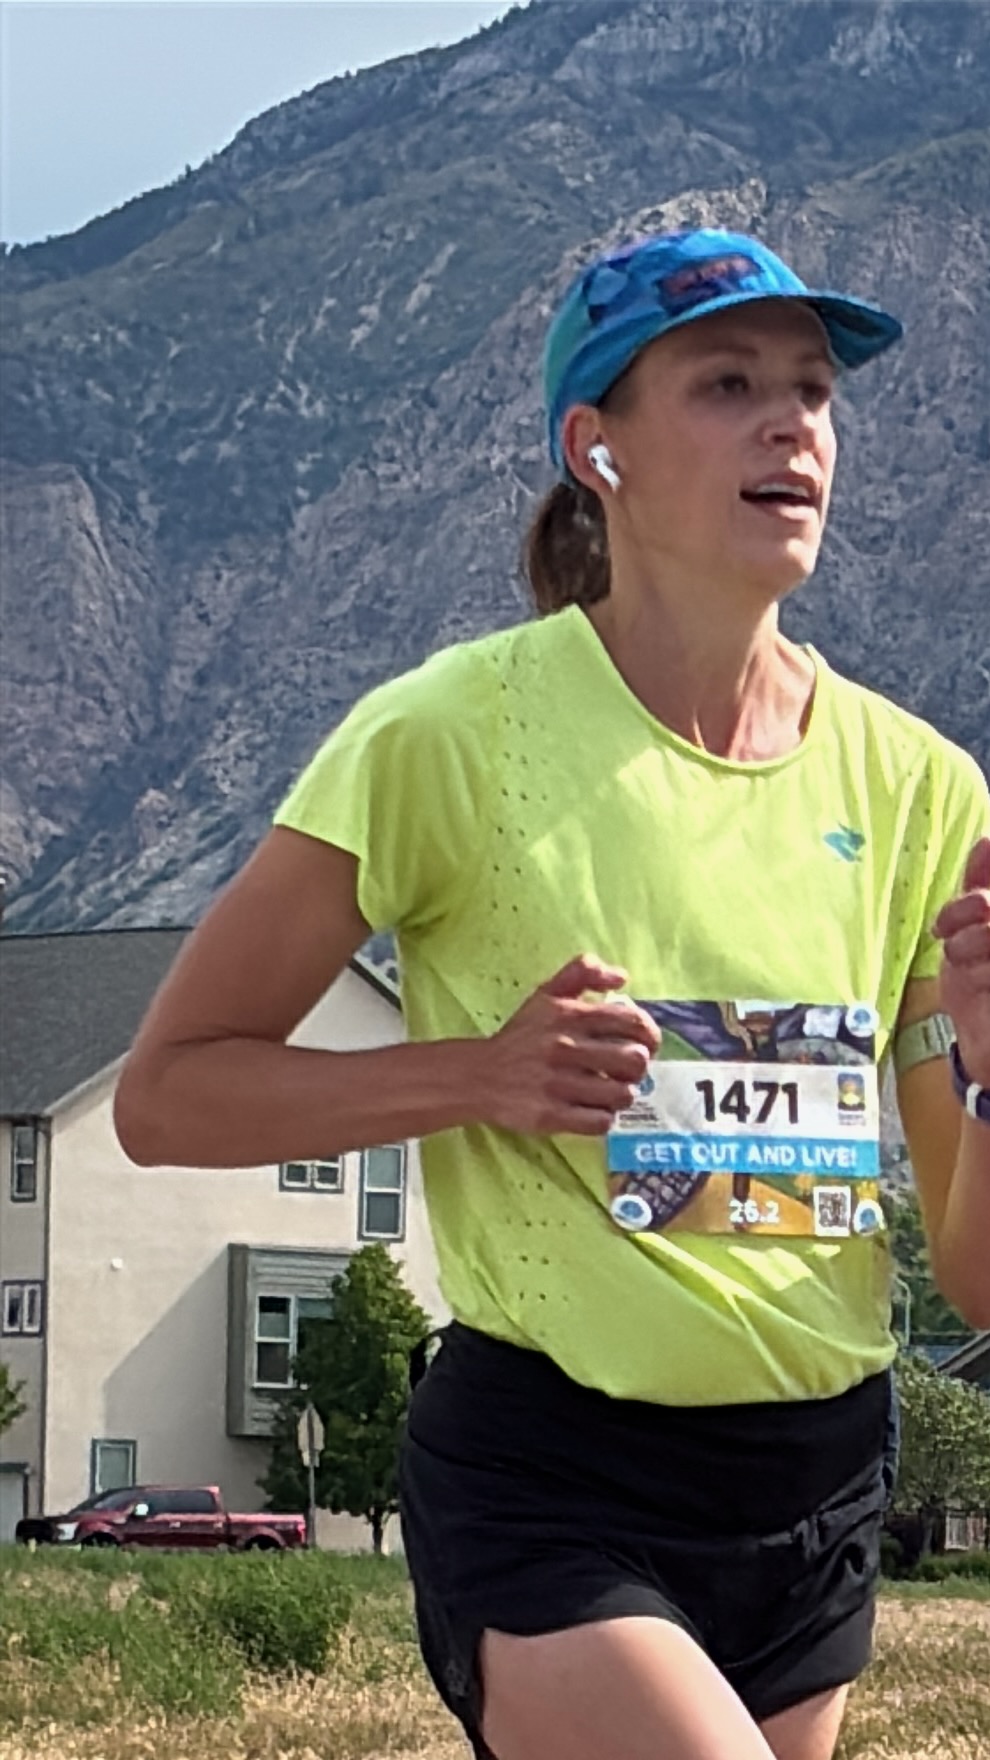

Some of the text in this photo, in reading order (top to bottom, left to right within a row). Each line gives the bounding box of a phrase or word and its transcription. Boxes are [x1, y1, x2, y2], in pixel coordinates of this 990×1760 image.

[696, 1079, 799, 1125] 1471
[635, 1142, 857, 1168] GET OUT AND LIVE!
[728, 1199, 781, 1225] 26.2
